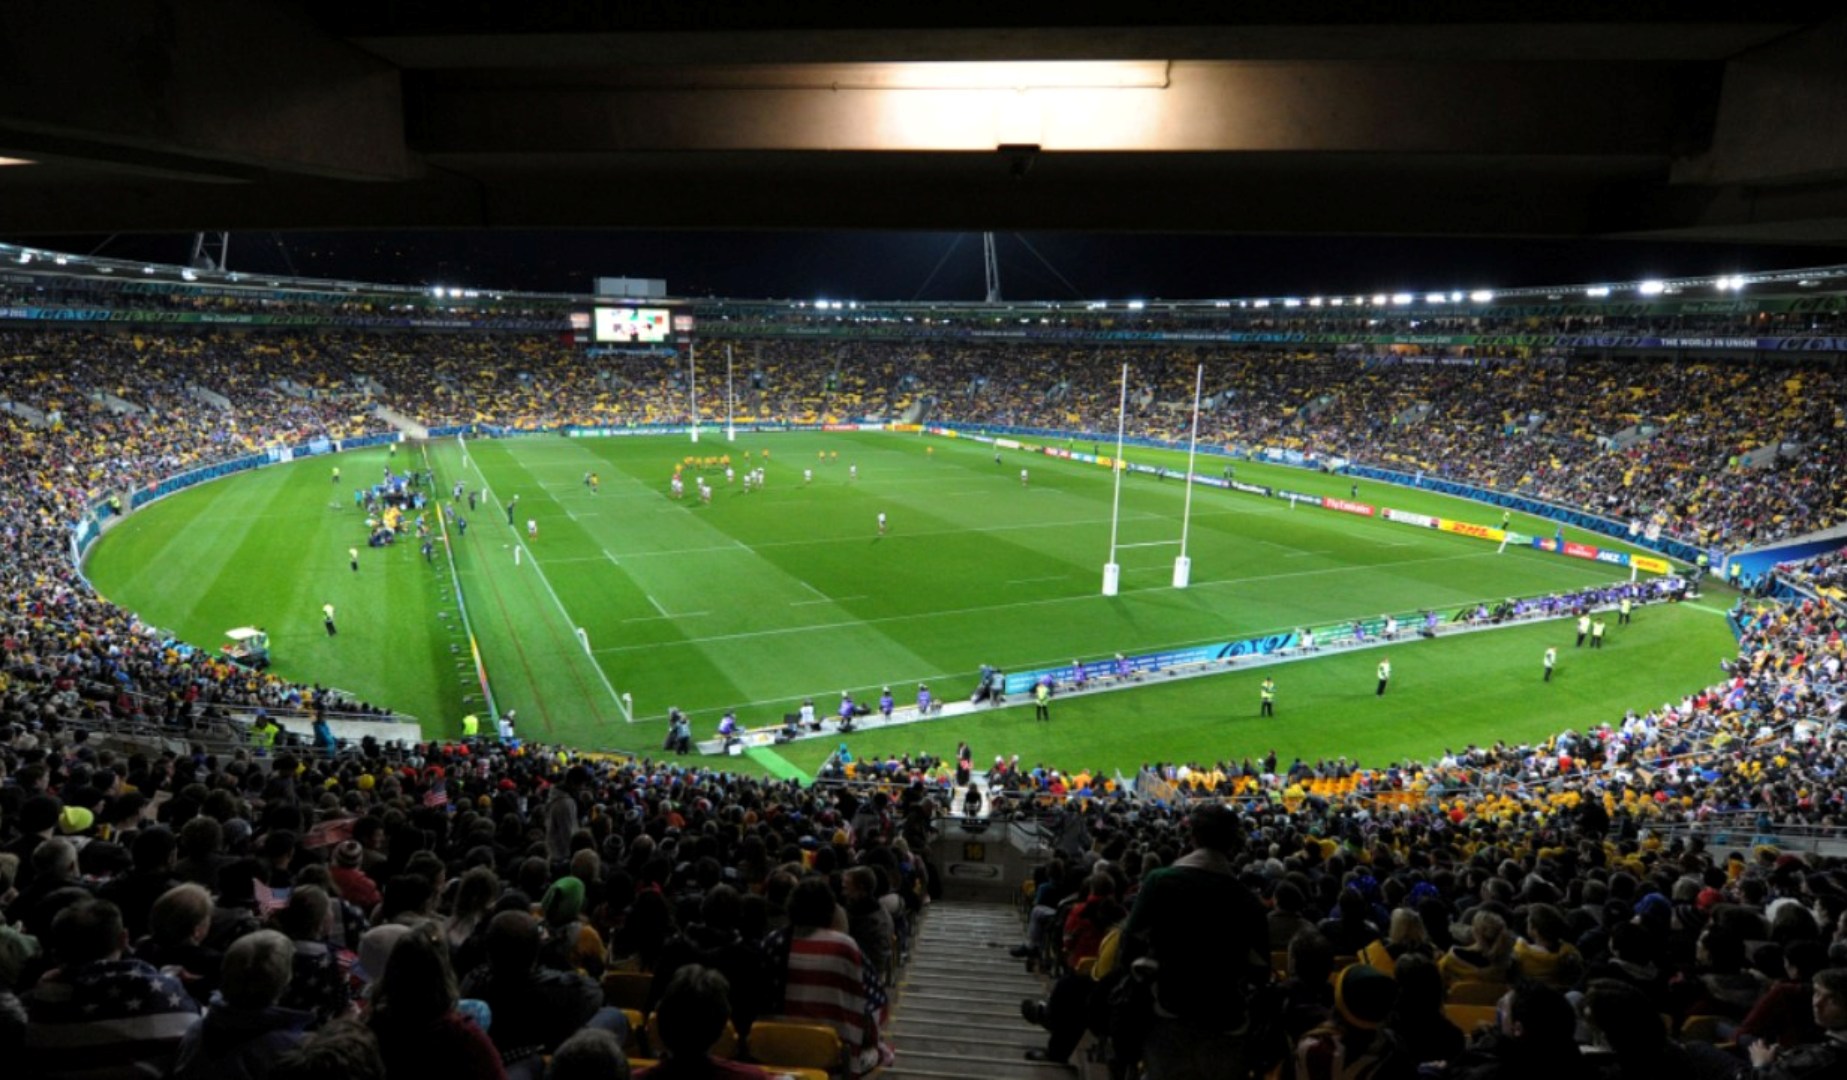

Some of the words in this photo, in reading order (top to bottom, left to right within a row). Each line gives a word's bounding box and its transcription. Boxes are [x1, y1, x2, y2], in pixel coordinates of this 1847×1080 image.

[1660, 338, 1678, 347] THE
[1679, 338, 1712, 347] WORLD
[1713, 338, 1724, 347] IN
[1725, 338, 1758, 348] UNION
[1453, 521, 1488, 537] DHL
[1596, 550, 1621, 563] ANZ
